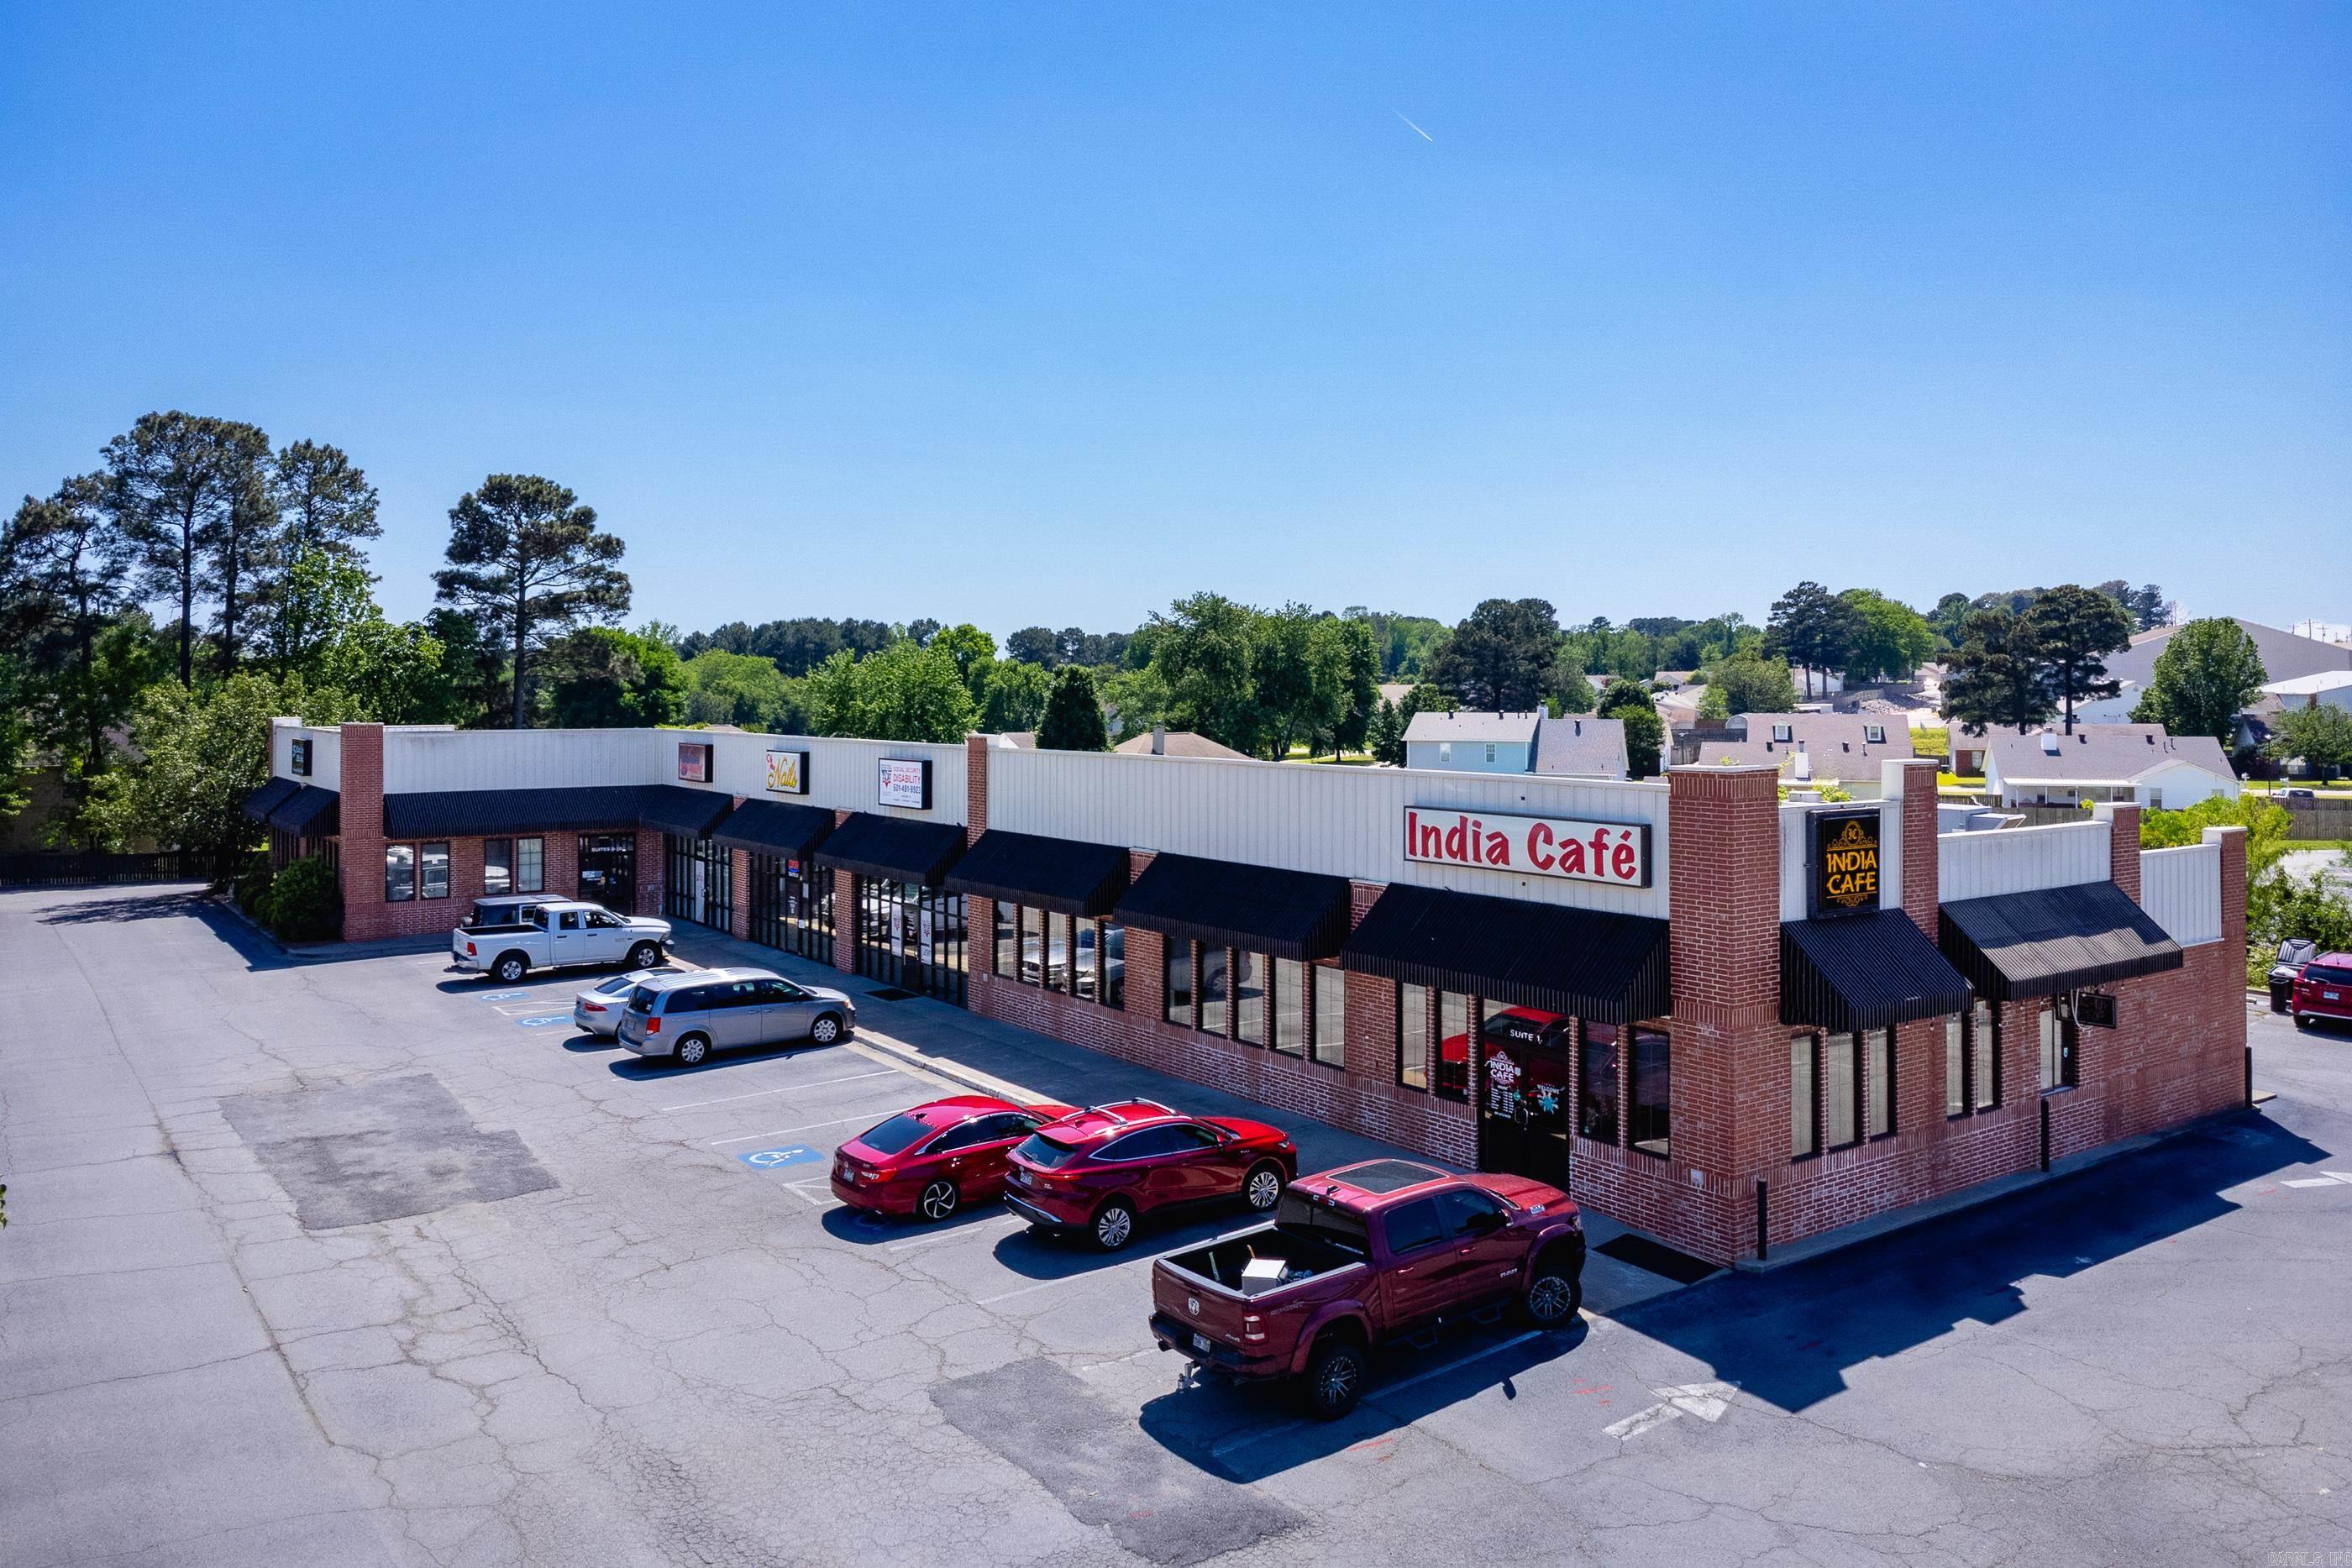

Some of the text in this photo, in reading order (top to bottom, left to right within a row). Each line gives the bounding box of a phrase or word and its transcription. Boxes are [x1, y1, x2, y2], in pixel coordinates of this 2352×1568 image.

[767, 756, 798, 789] Nails
[893, 773, 921, 784] DISABILITY
[1408, 811, 1637, 880] India Café
[1826, 850, 1877, 873] INDIA
[1826, 871, 1876, 894] CAFE
[1509, 1029, 1534, 1041] SUITE
[1489, 1061, 1515, 1073] INDIA
[1489, 1069, 1515, 1082] CAFE
